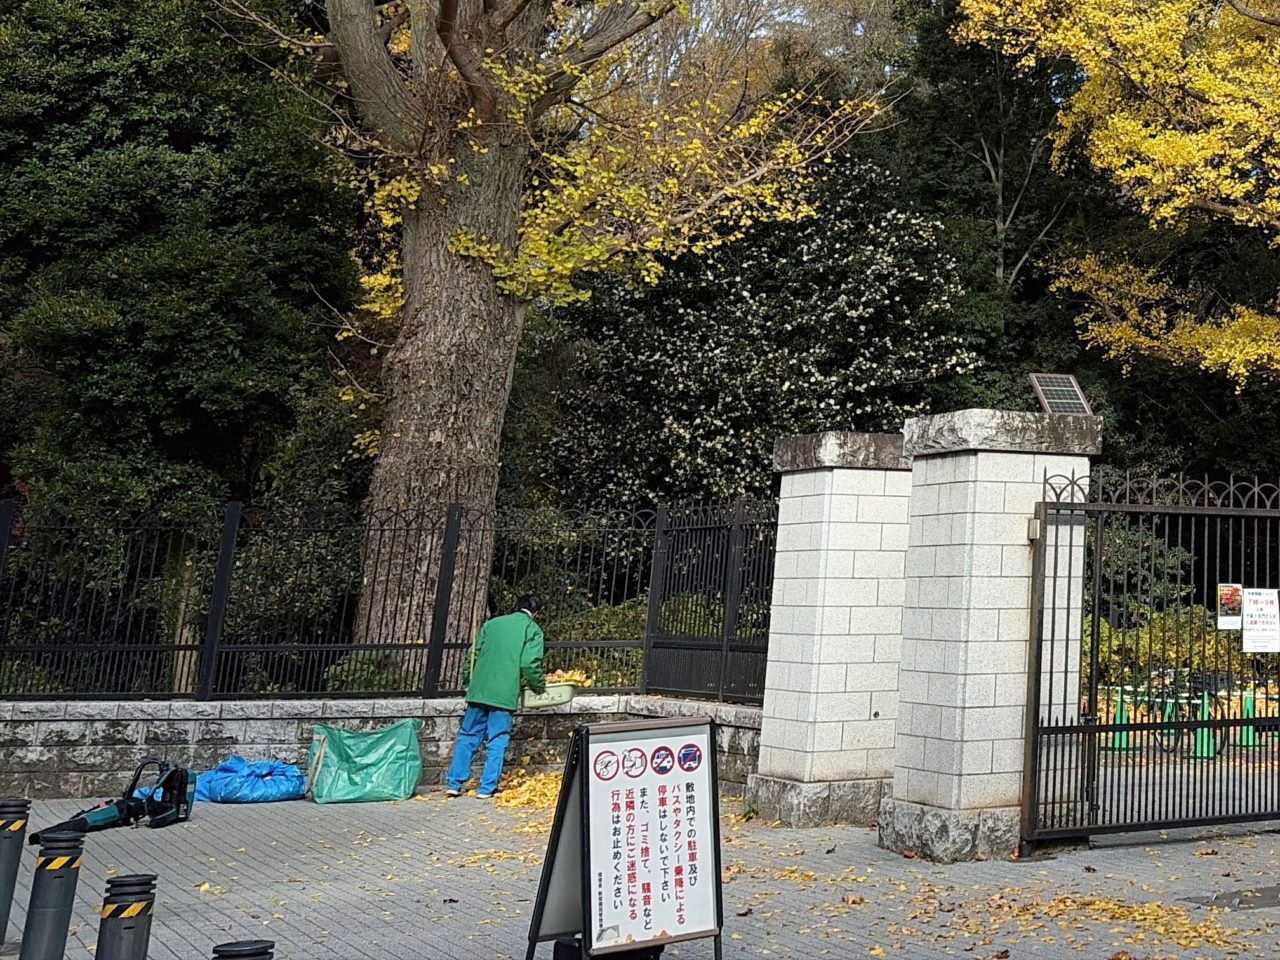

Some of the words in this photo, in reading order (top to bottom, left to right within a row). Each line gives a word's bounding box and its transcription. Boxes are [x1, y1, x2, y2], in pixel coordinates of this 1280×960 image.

[611, 789, 623, 910] 行為はお止めください
[624, 788, 638, 921] 近隣の方にご迷惑になる
[657, 784, 671, 903] 停車はしないで下さい
[671, 784, 685, 925] バスやタクシー乗降による
[685, 782, 698, 887] 敷地内での駐車及び
